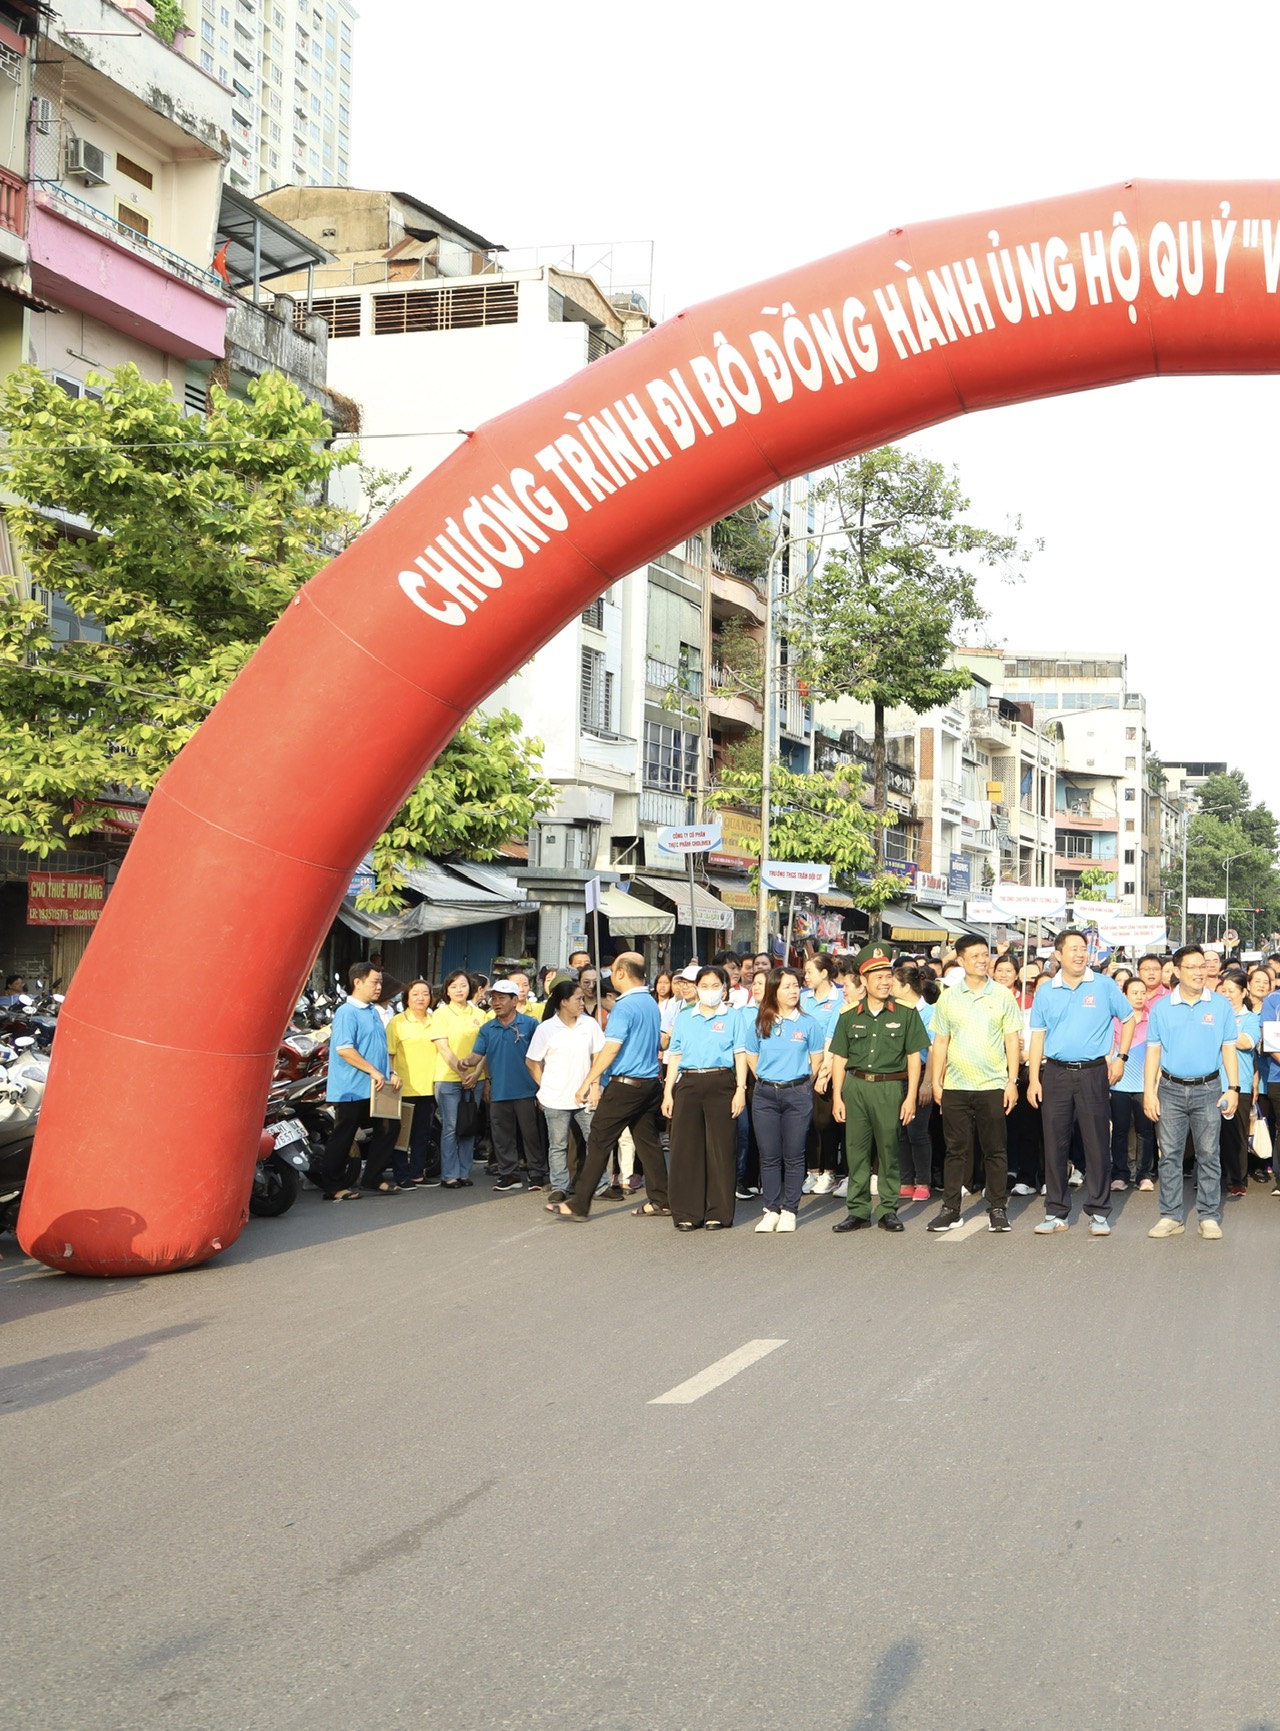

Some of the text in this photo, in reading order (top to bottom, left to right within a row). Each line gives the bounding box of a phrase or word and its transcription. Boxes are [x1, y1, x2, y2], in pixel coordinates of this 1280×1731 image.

[398, 467, 569, 627] CHƯƠNG
[534, 394, 672, 512] TRÌNH
[645, 368, 713, 451] ĐI
[749, 297, 878, 404] ĐỒNG
[873, 257, 995, 360] HÀNH
[987, 230, 1076, 324] ỦNG
[1080, 211, 1140, 324] HỘ
[723, 817, 752, 831] QUANG
[31, 882, 46, 898] CHO
[48, 880, 65, 898] THUÊ
